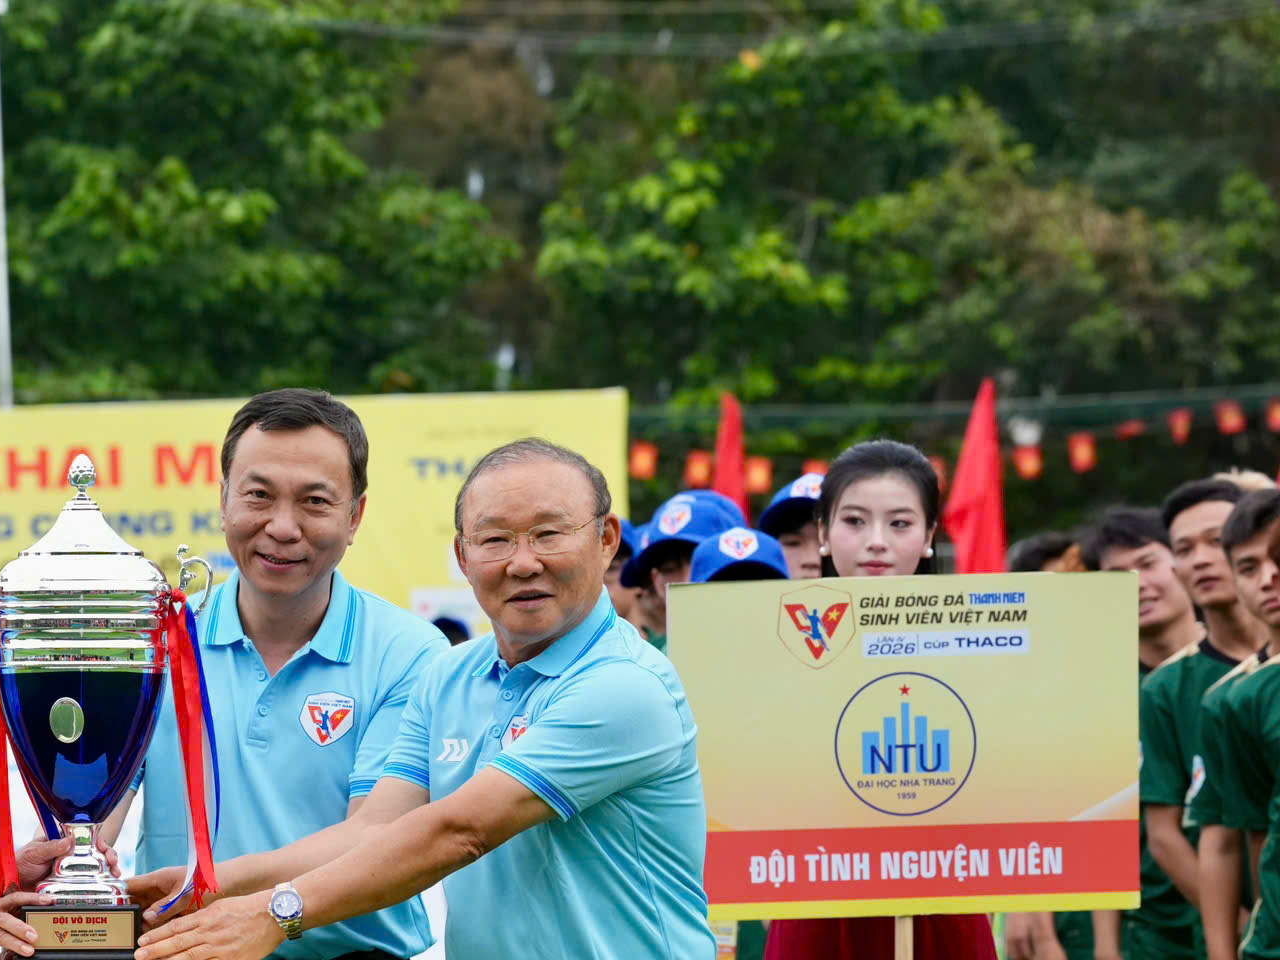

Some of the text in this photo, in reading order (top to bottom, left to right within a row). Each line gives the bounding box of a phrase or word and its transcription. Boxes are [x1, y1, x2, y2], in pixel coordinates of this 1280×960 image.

[859, 592, 890, 609] GIẢI
[895, 592, 939, 608] BÓNG
[943, 592, 965, 607] ĐÁ
[859, 608, 1028, 626] SINH VIÊN VIỆT NAM
[867, 642, 916, 656] 2026
[954, 635, 1023, 648] THACO
[870, 743, 941, 774] NTU
[900, 779, 920, 787] NHA
[923, 777, 956, 786] TRANG
[749, 841, 1063, 888] ĐỘI TÌNH NGUYỆN VIÊN
